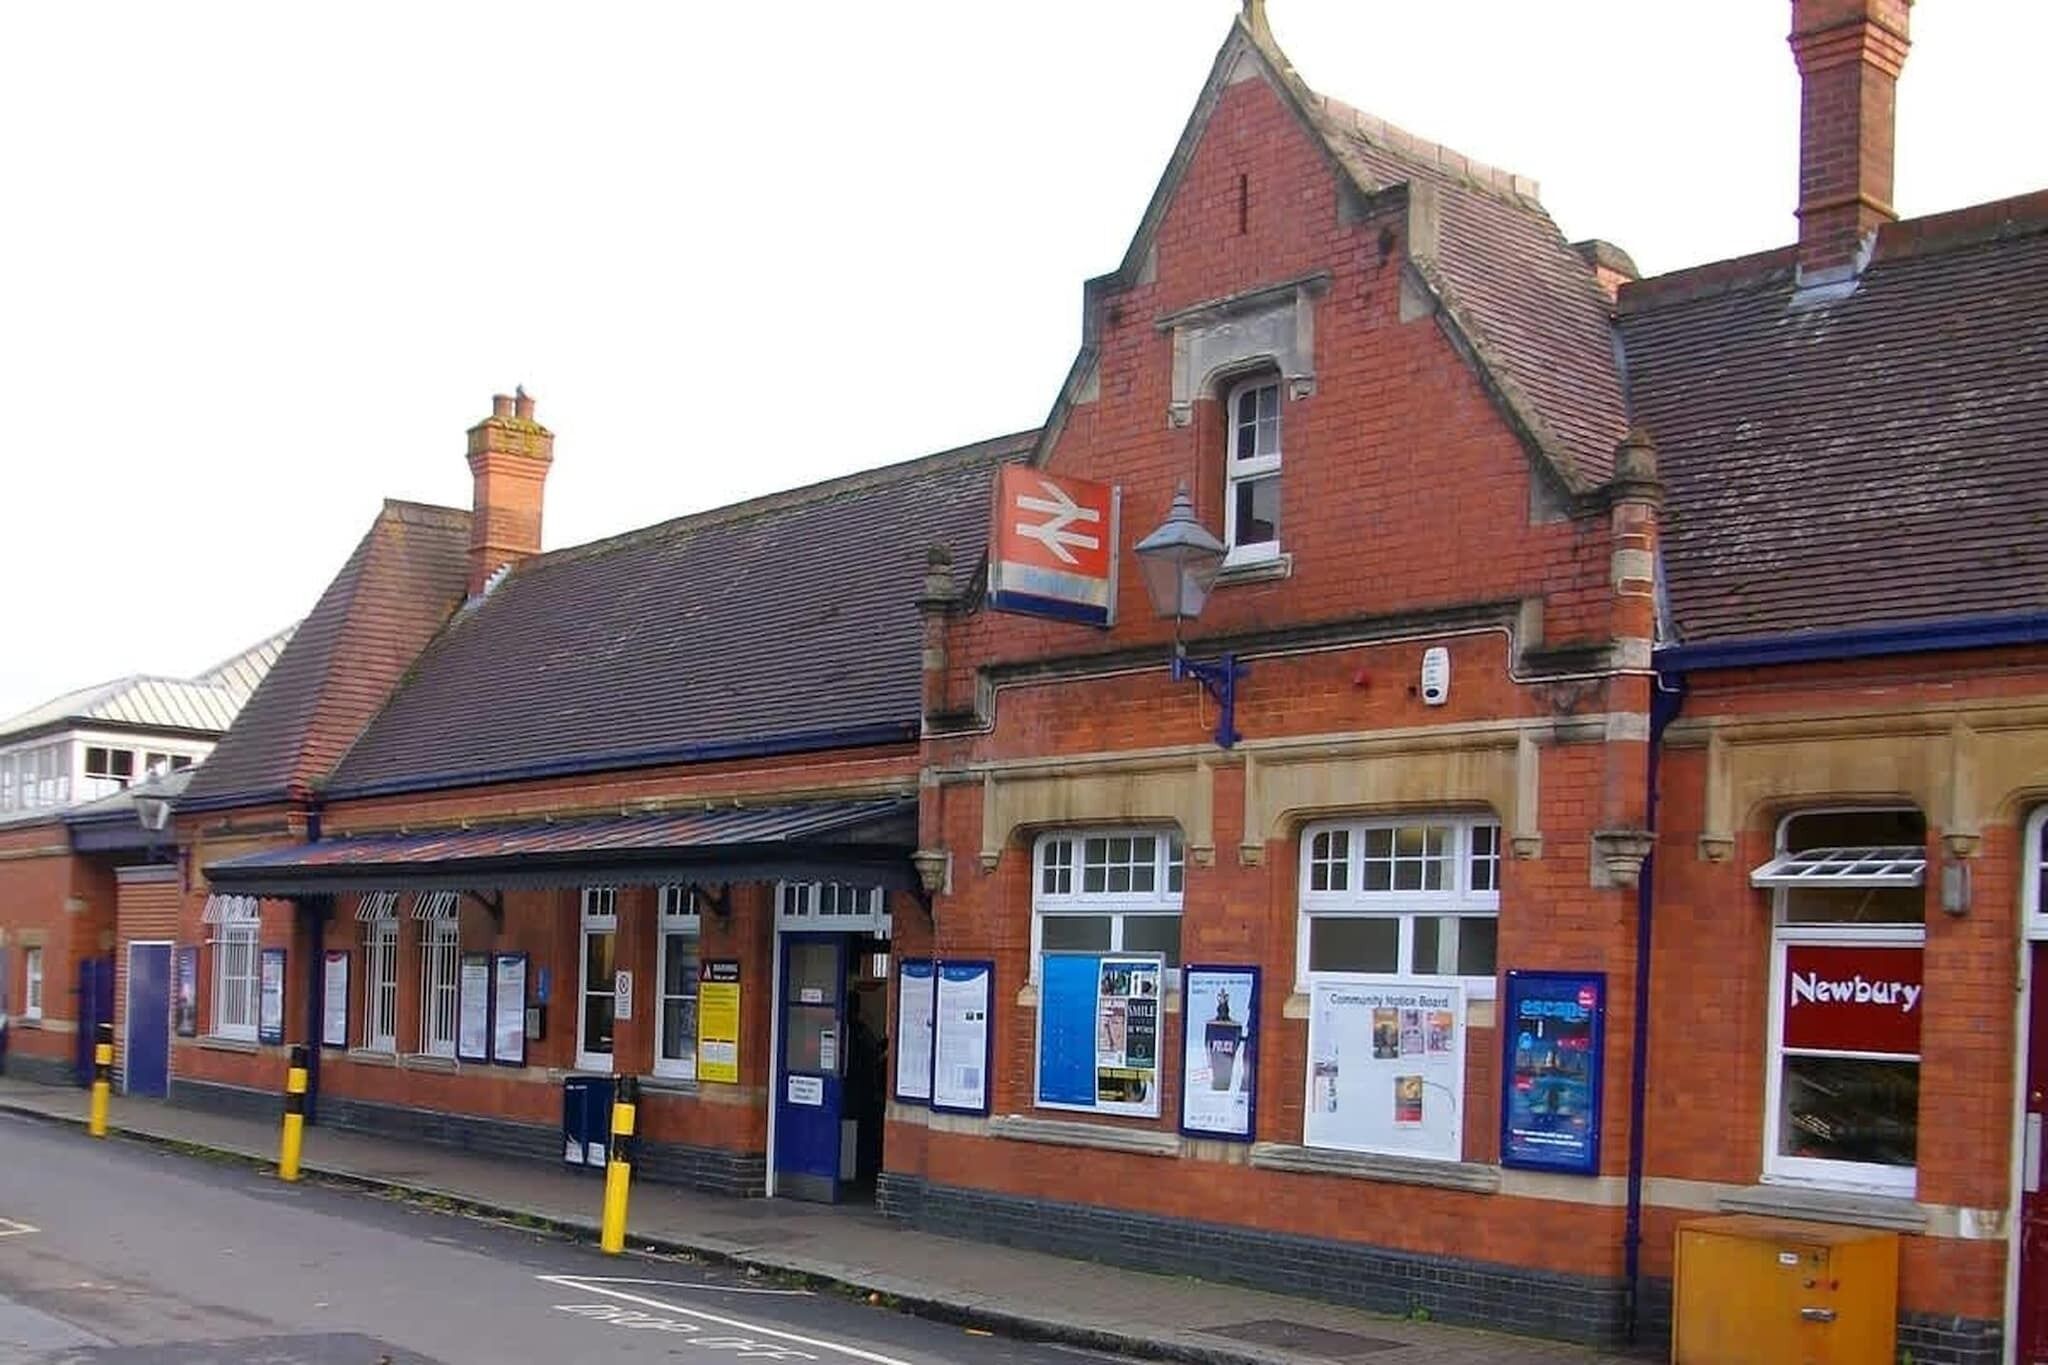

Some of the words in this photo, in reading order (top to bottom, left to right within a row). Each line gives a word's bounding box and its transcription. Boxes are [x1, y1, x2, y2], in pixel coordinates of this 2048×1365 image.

[1791, 972, 1922, 1012] Newbury
[1329, 993, 1382, 1007] Community
[1386, 995, 1417, 1006] Notice
[1419, 996, 1449, 1008] Board
[1127, 1004, 1157, 1017] SMILE
